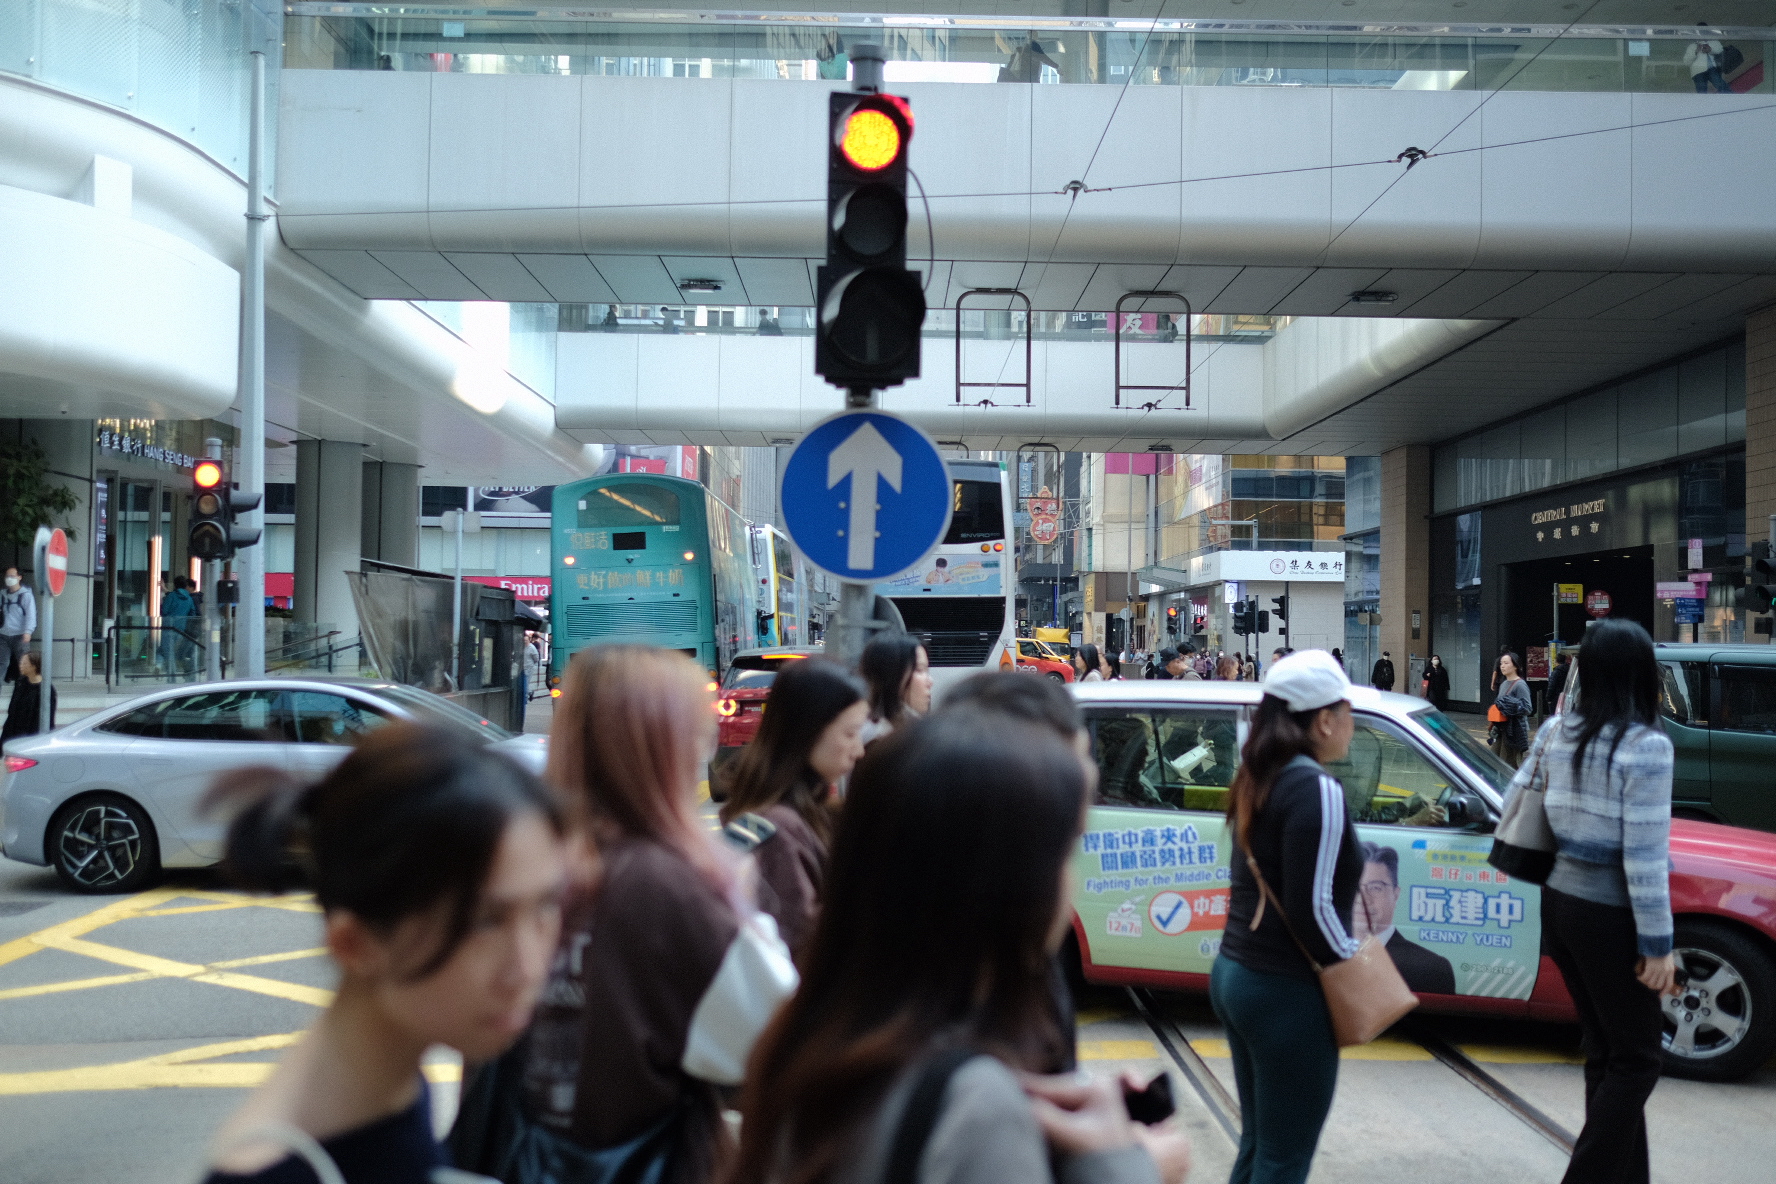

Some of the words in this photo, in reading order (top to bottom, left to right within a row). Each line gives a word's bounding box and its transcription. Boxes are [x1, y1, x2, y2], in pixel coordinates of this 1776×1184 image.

[1119, 313, 1146, 334] 友
[144, 445, 163, 461] HANG
[165, 451, 182, 466] SENG
[1531, 507, 1566, 525] CENTRAL
[1570, 499, 1605, 518] MARKET
[1034, 519, 1055, 539] 押
[1289, 559, 1343, 571] 集友銀行
[500, 581, 550, 597] Emira
[1083, 824, 1198, 852] 捍衛中產夾心
[1086, 877, 1131, 894] Fighting
[1134, 875, 1149, 887] for
[1153, 873, 1171, 885] the
[1175, 870, 1212, 883] Middle
[1215, 868, 1232, 880] Cla
[1193, 895, 1231, 916] 中產
[1411, 885, 1524, 929] 阮建中
[1419, 929, 1467, 944] KENNY
[1473, 933, 1512, 948] YUEN
